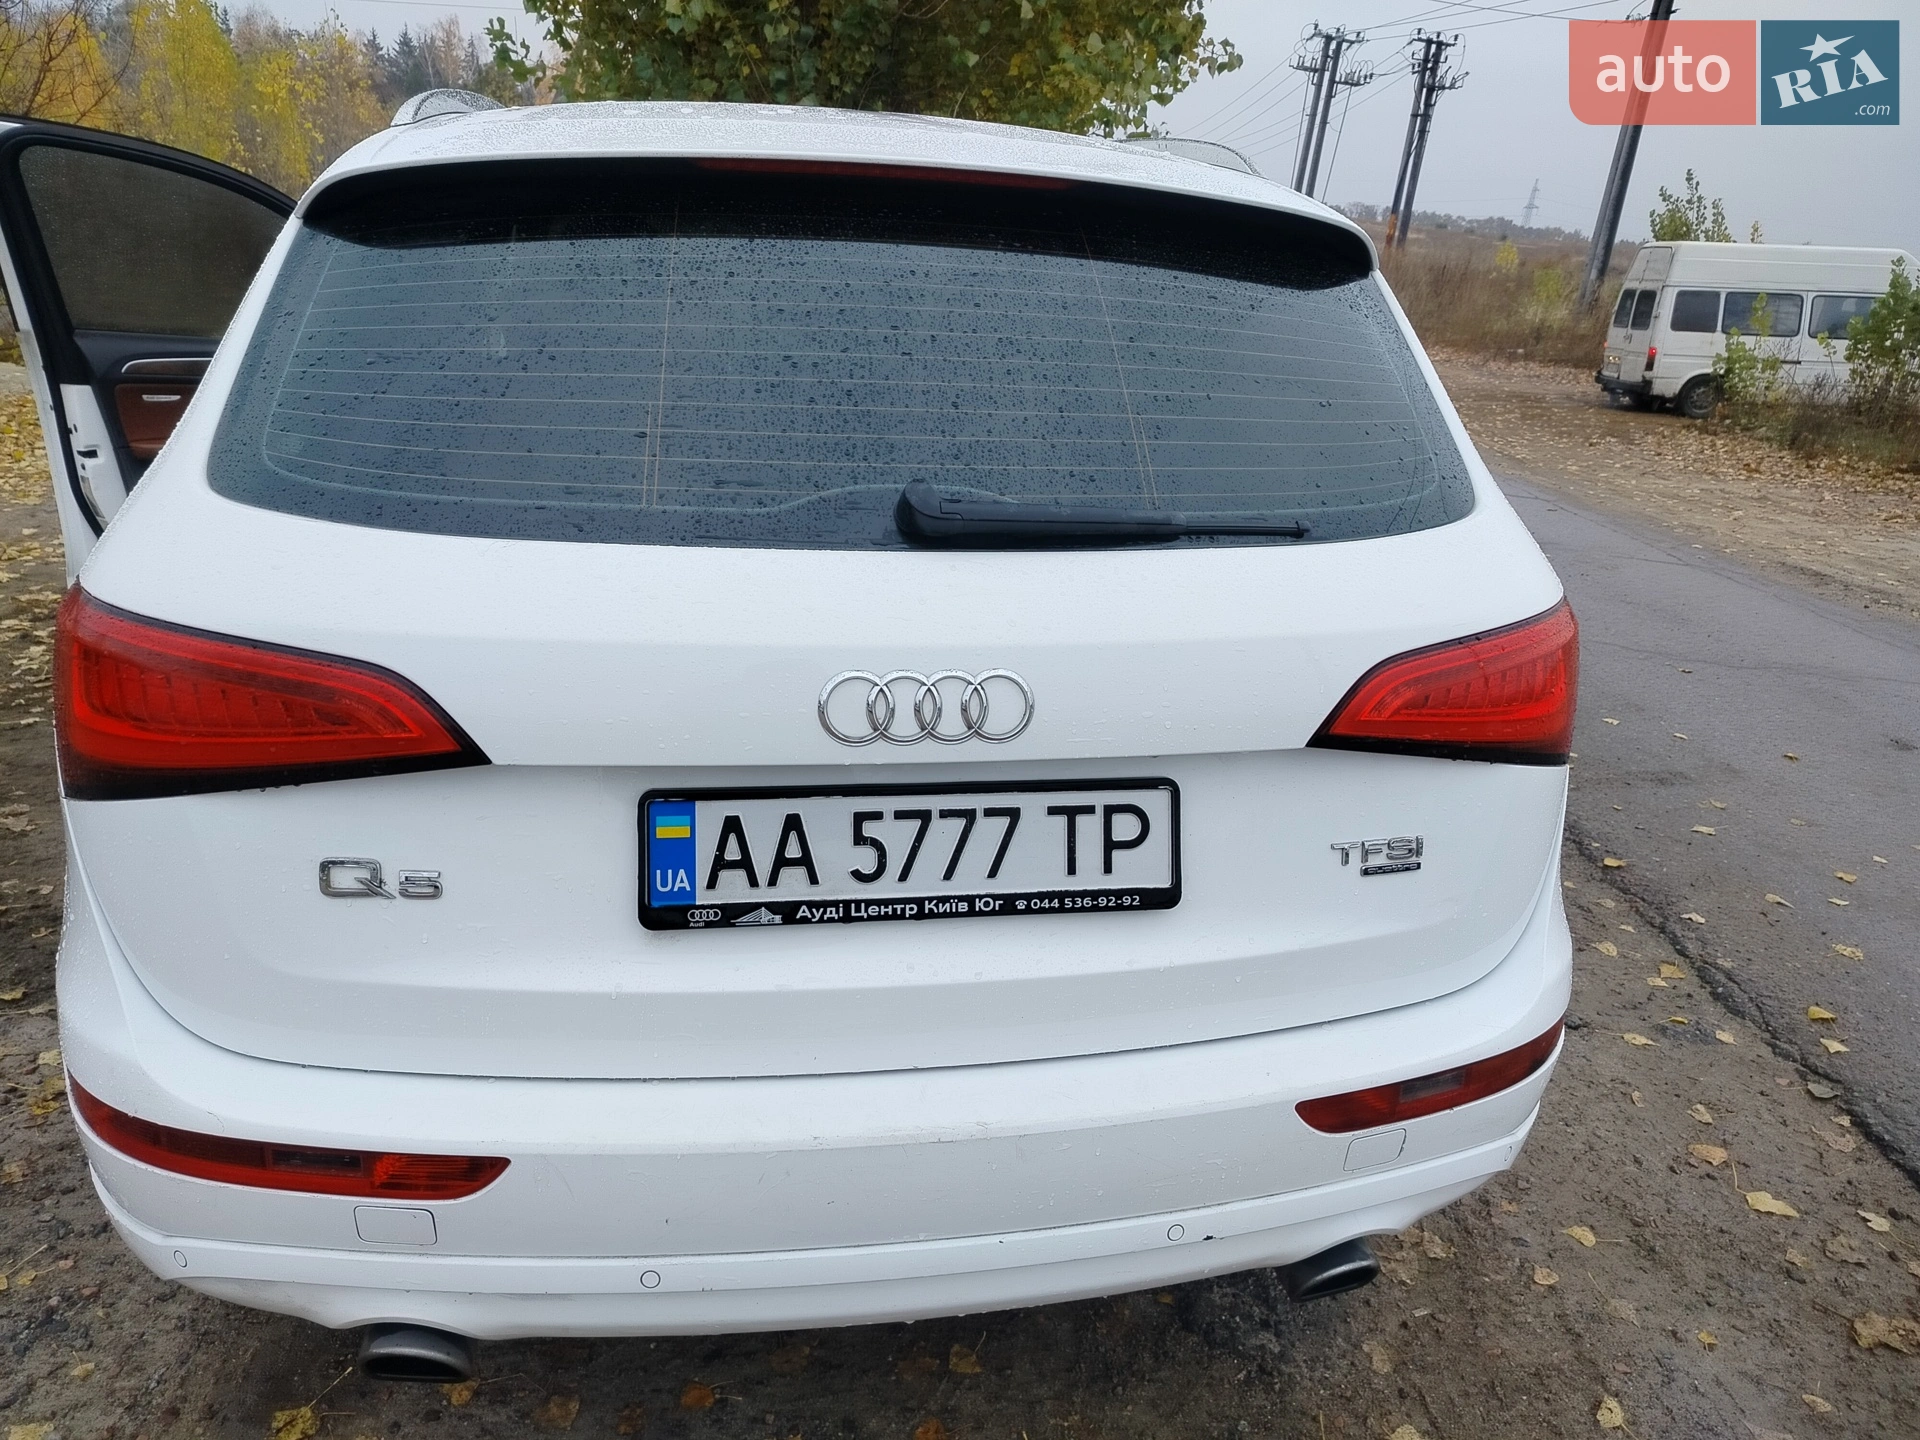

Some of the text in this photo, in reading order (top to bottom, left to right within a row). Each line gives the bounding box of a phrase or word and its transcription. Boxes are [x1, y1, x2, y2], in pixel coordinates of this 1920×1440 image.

[705, 803, 1151, 890] AA 5777 TP
[1330, 835, 1424, 867] TFSI
[318, 857, 444, 900] Q5
[655, 868, 691, 893] UA
[795, 895, 1141, 922] Ауді Центр Київ Юг 044 536-92-92
